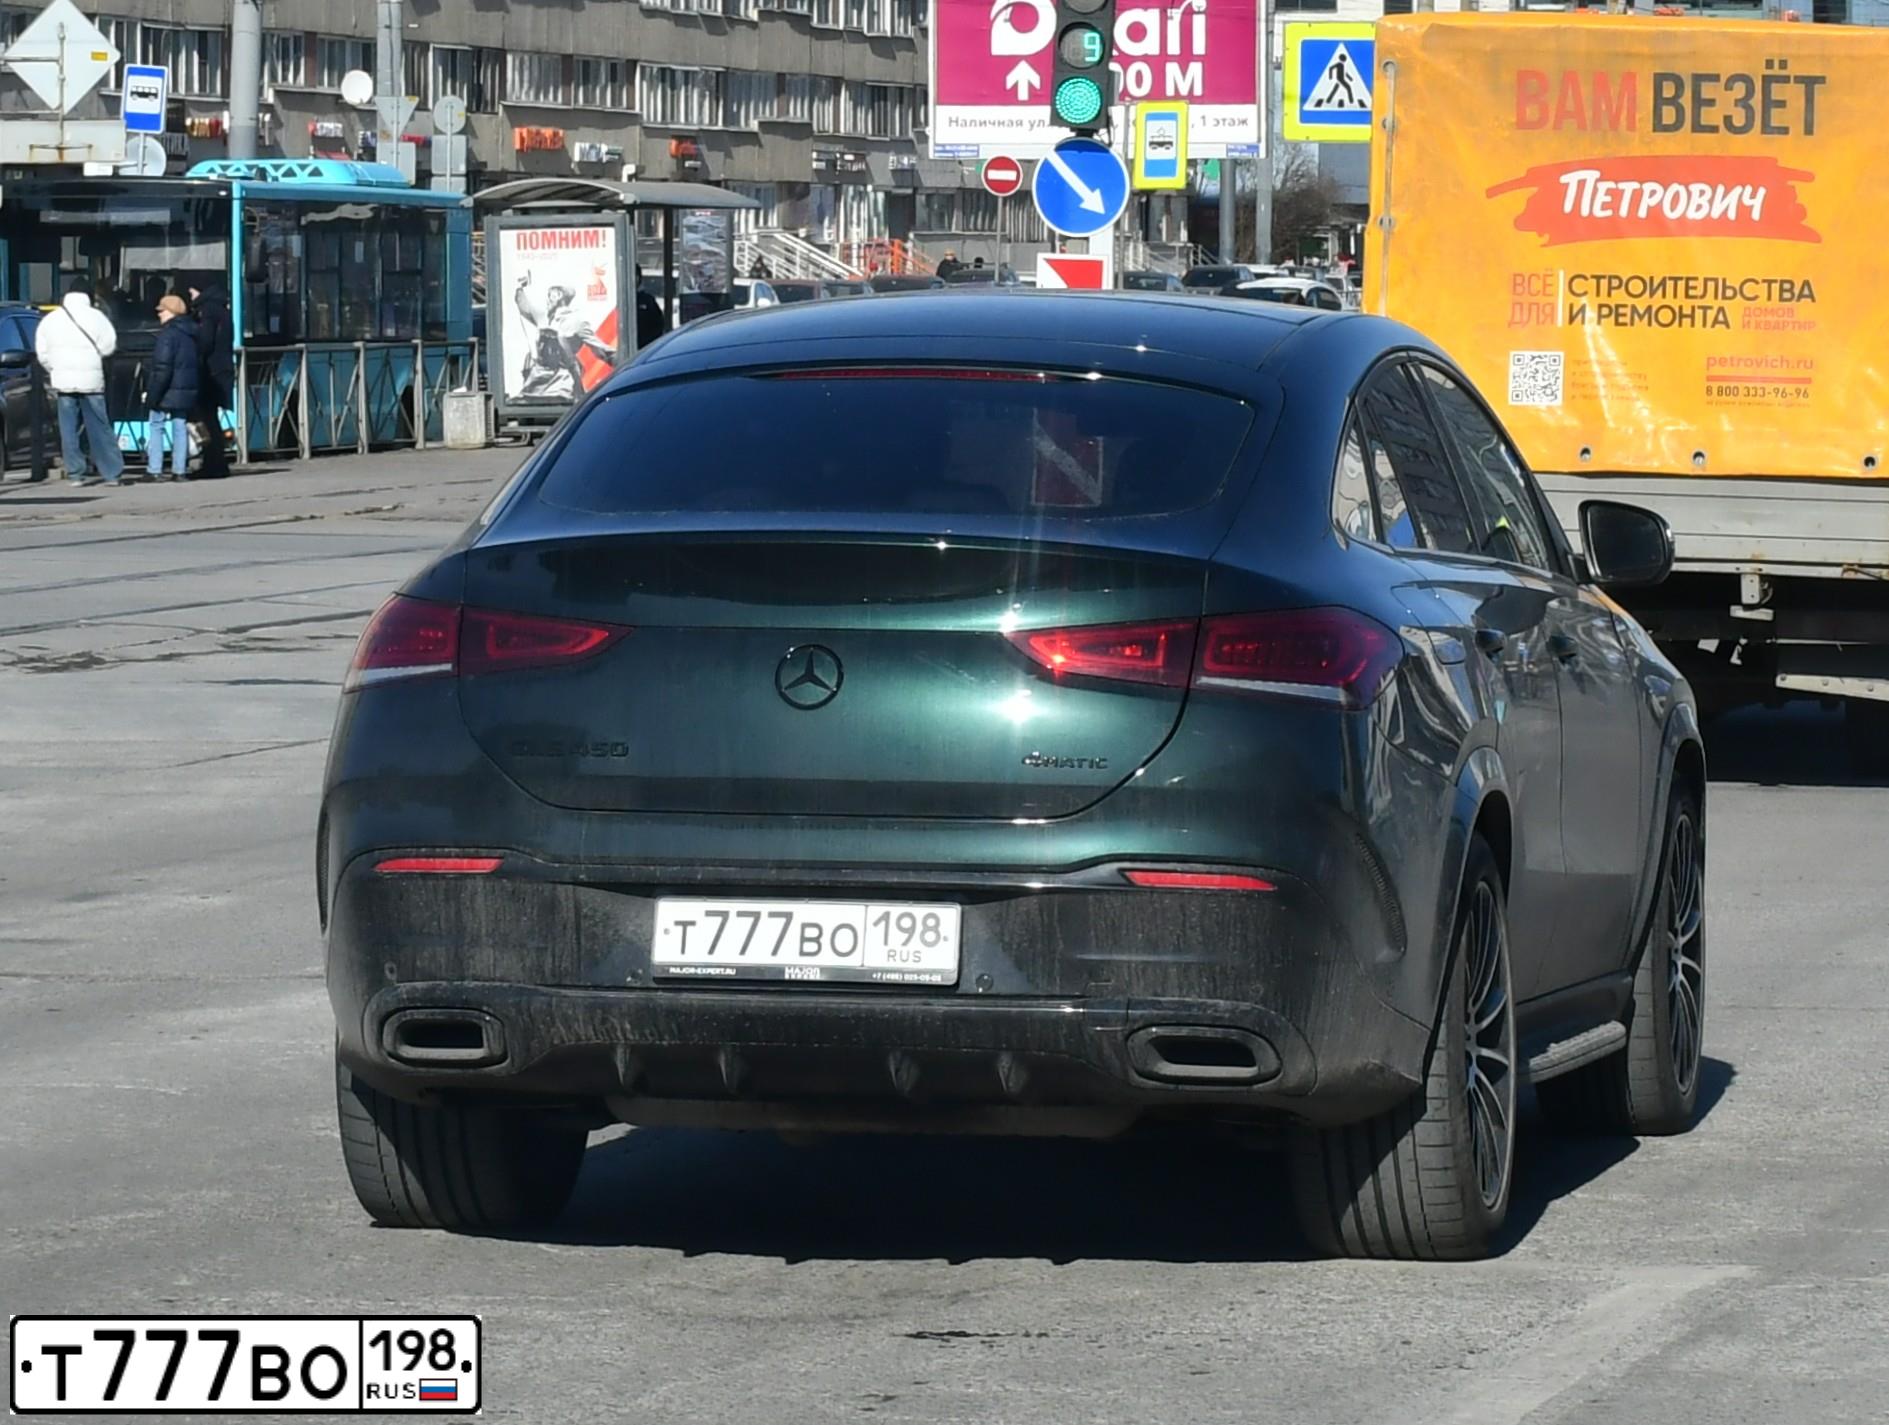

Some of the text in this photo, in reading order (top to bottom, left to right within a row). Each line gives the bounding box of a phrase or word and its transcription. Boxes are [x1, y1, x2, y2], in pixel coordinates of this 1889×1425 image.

[1084, 32, 1101, 62] 9
[1514, 59, 1827, 136] ВАМ ВЕЗЁТ
[948, 116, 1024, 128] Наличная
[1200, 115, 1249, 128] 1 этаж
[516, 230, 607, 251] ПОМНИМ!
[1512, 268, 1555, 297] ВСЁ
[1568, 273, 1817, 304] СТРОИТЕЛЬСТВА
[1508, 302, 1555, 329] ДЛЯ
[1568, 303, 1731, 329] И РЕМОНТА
[1742, 306, 1795, 319] ДОМОВ
[1755, 319, 1817, 331] КВАРТИР
[1706, 355, 1814, 371] petrovich.ru
[1705, 385, 1810, 399] 8 800 333-96-96
[673, 910, 941, 958] Т777ВО 198
[886, 949, 922, 963] RUS
